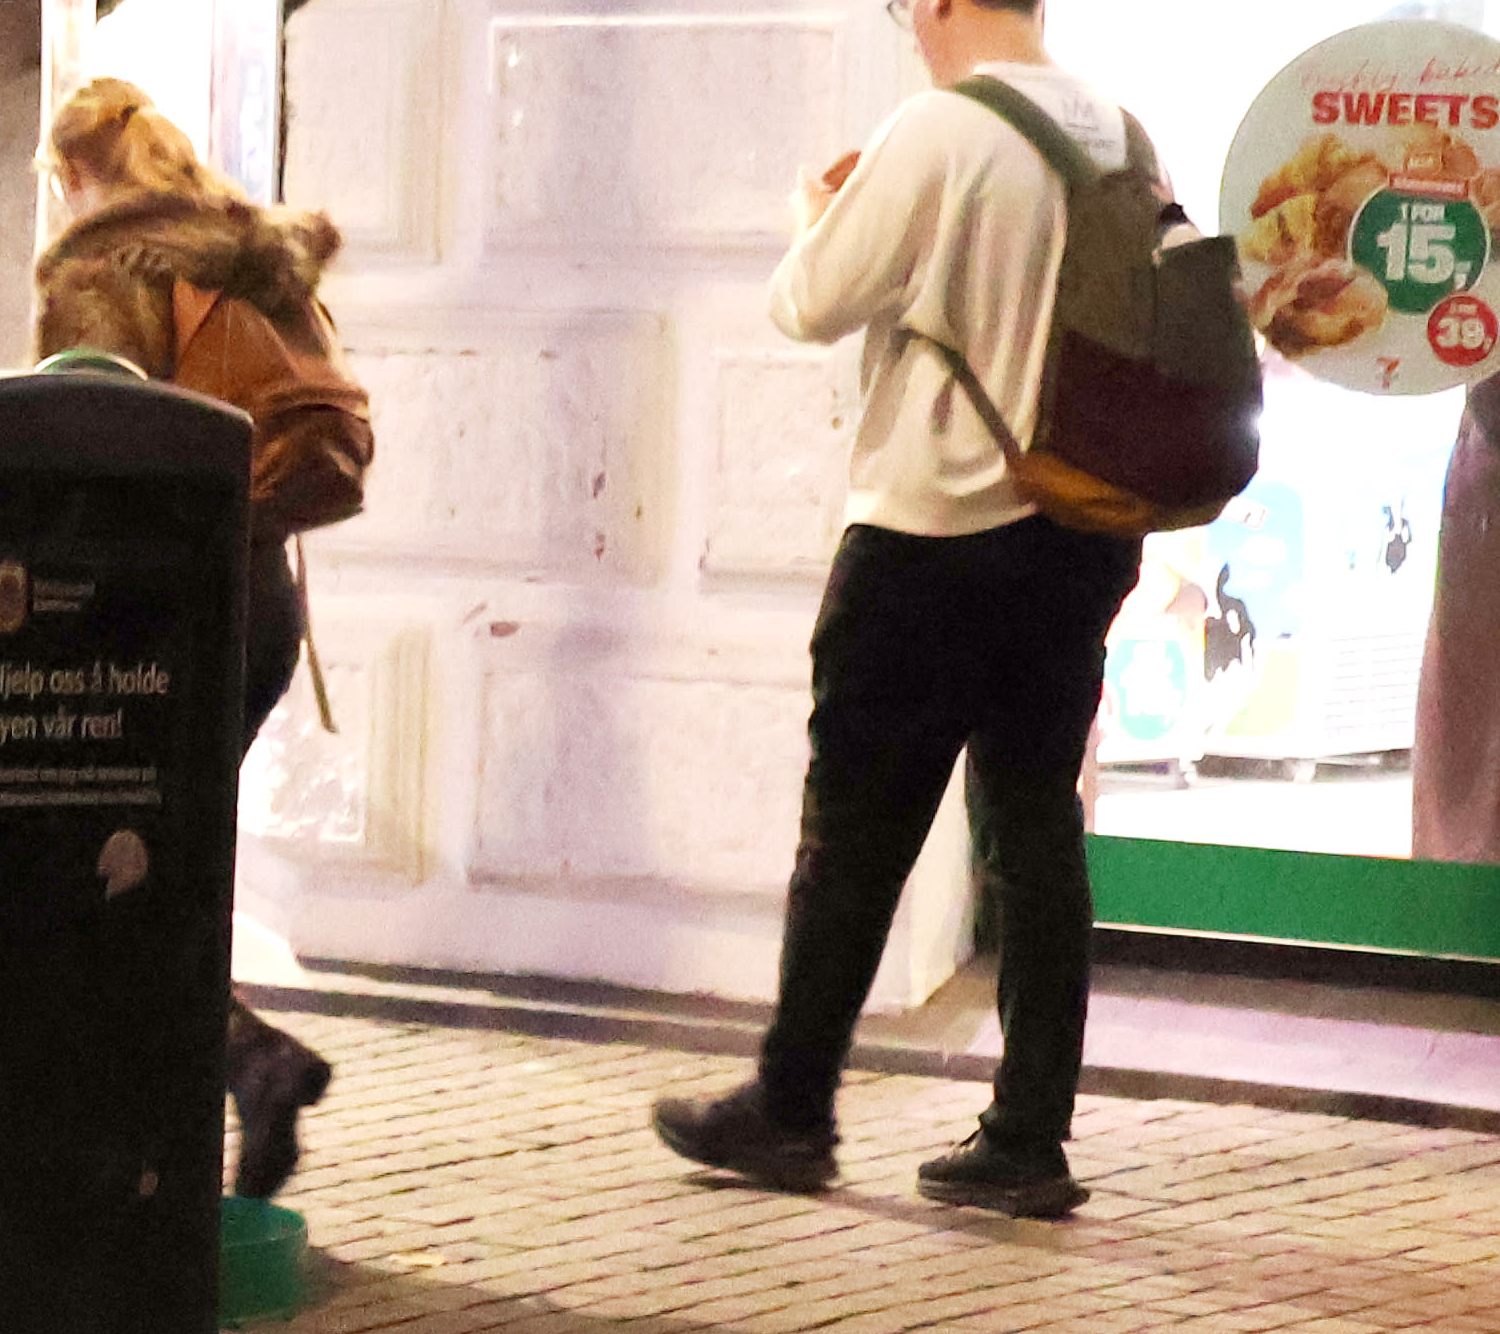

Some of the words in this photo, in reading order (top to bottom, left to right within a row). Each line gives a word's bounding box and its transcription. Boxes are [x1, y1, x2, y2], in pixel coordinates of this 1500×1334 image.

[1312, 91, 1499, 130] SWEETS
[50, 670, 86, 695] oss
[109, 661, 170, 695] holde
[42, 705, 76, 739] vår
[81, 708, 123, 739] ren!
